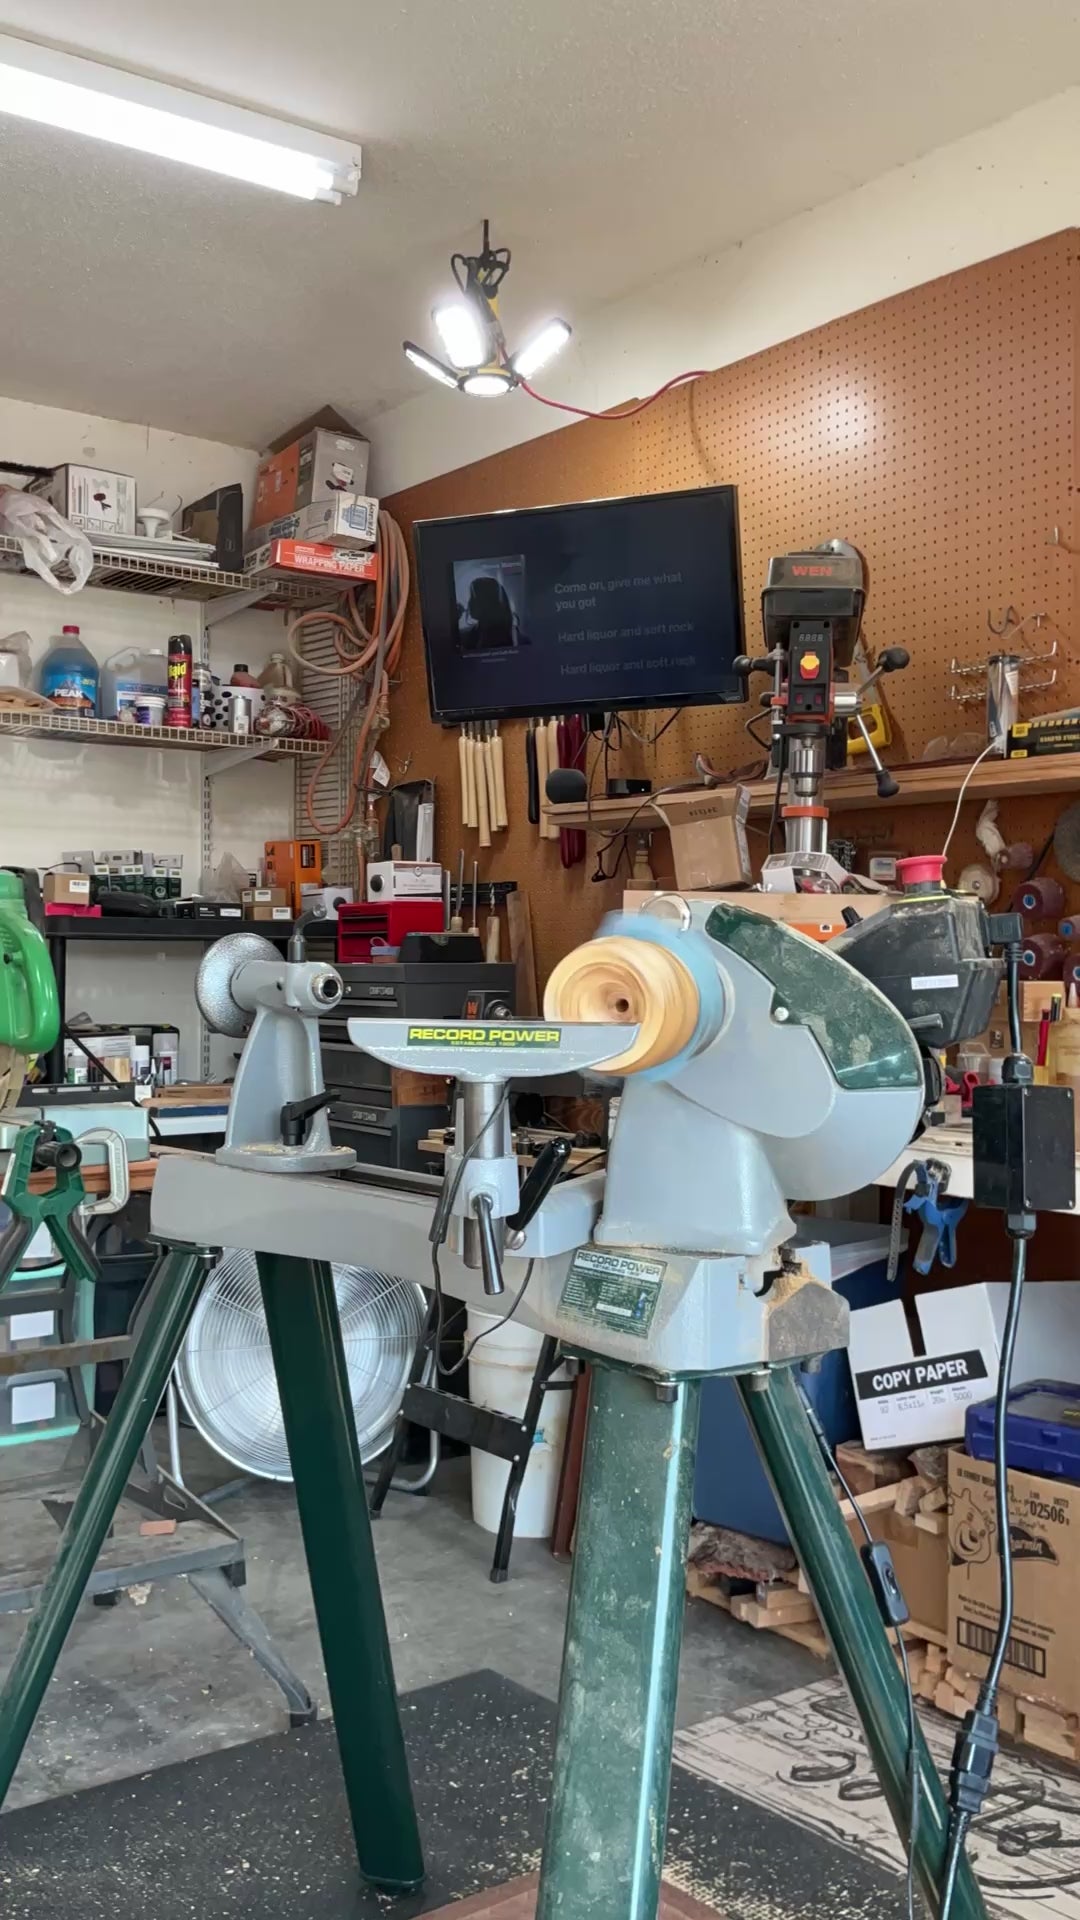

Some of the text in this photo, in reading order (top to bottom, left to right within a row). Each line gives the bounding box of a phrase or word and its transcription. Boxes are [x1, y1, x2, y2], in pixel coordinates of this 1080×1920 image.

[294, 555, 365, 573] WRAPPING PAPER
[791, 565, 833, 577] WEN
[554, 583, 588, 594] Come
[607, 577, 632, 592] give
[633, 576, 651, 586] me
[652, 571, 683, 585] what
[555, 596, 597, 612] you got
[557, 631, 585, 643] Hard
[586, 628, 618, 641] liquor
[620, 626, 642, 638] and
[668, 621, 695, 633] rock
[560, 663, 588, 676] Hard
[588, 661, 621, 675] liquor
[53, 688, 84, 698] PEAK
[409, 1028, 560, 1042] RECORD POWER
[577, 1251, 660, 1275] RECORD POWER
[872, 1359, 969, 1392] COPY PAPER
[1030, 1500, 1065, 1525] 02506
